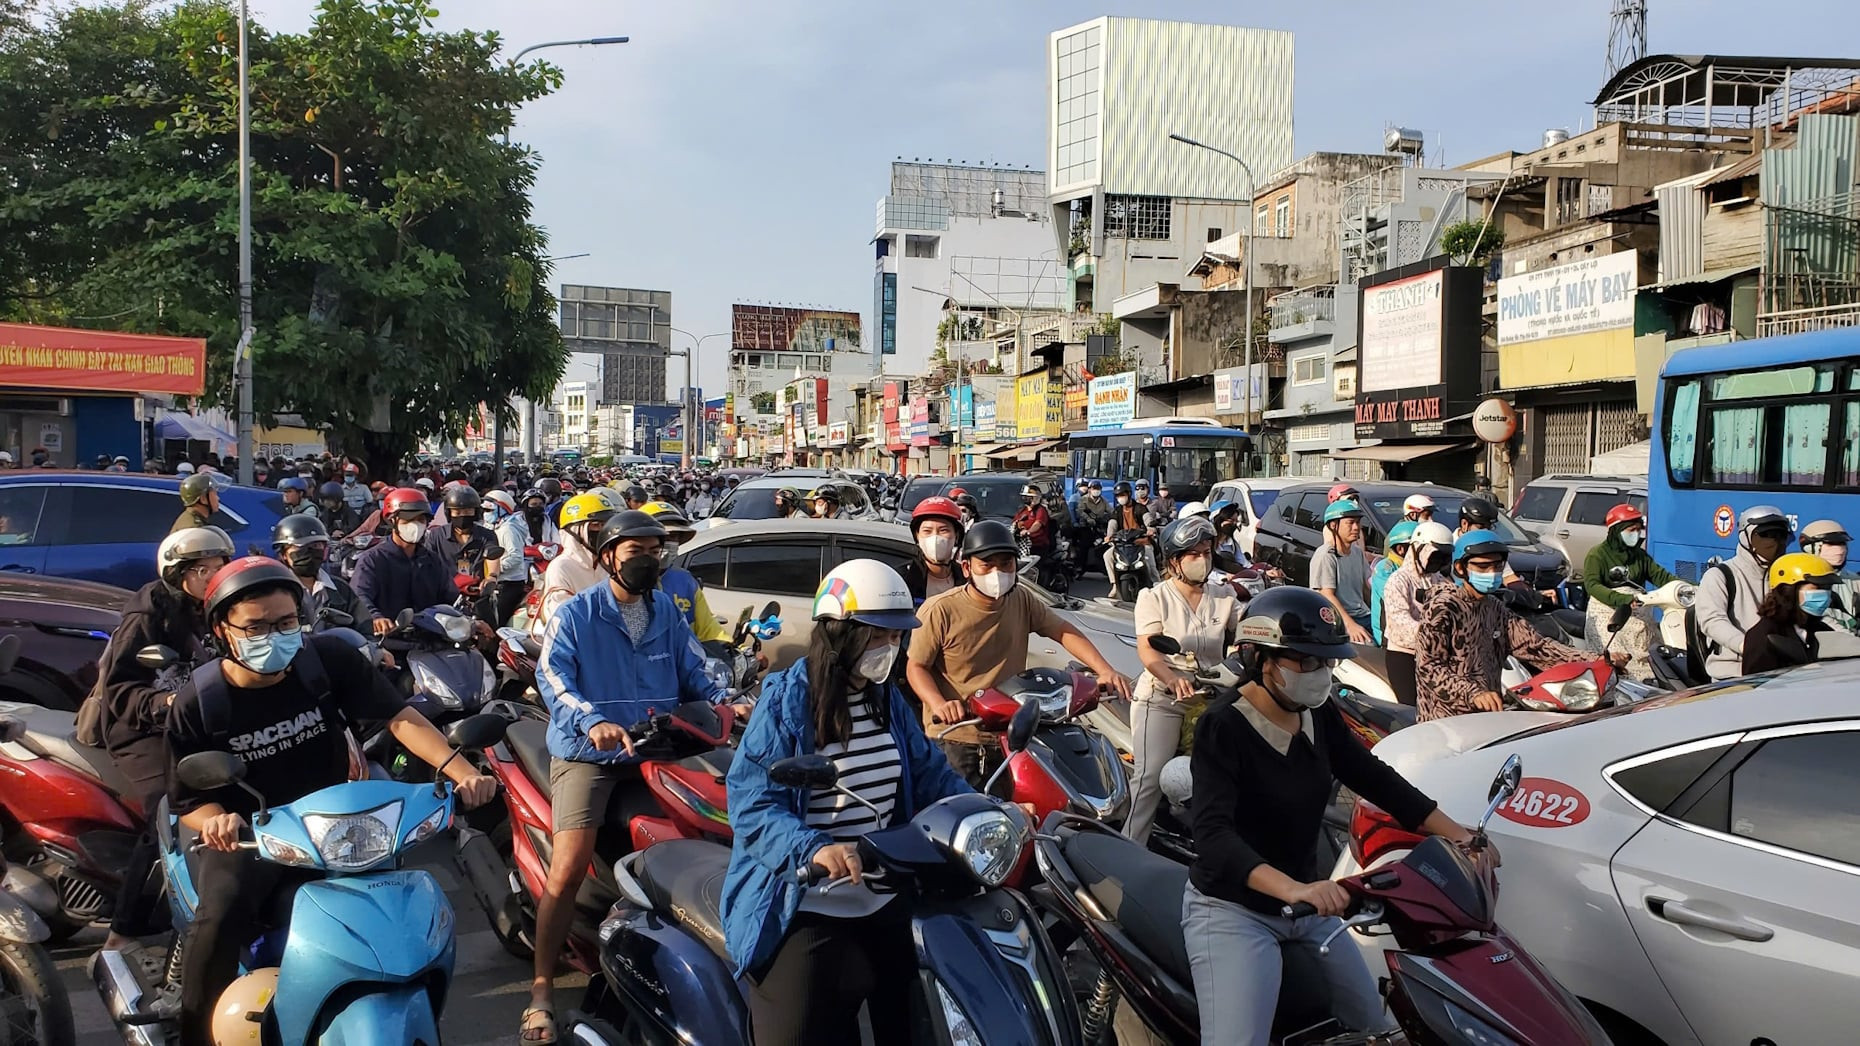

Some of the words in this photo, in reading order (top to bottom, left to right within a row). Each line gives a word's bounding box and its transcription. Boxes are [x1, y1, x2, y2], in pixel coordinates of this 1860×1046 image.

[1378, 281, 1427, 314] THANH
[1501, 285, 1541, 321] PHÒNG
[1565, 273, 1597, 310] MÁY
[1601, 271, 1632, 304] BAY
[55, 345, 86, 370] CHÍNH
[108, 352, 123, 372] TAI
[124, 353, 143, 377] NẠN
[144, 355, 166, 375] GIAO
[167, 352, 195, 376] THÔNG
[1355, 397, 1375, 424] MÁY
[1377, 401, 1398, 423] MAY
[1402, 397, 1440, 421] THANH
[1479, 413, 1507, 422] Jetstar
[996, 427, 1017, 438] 560
[279, 739, 292, 751] IN
[295, 723, 327, 745] SPACE
[367, 880, 401, 890] HONDA
